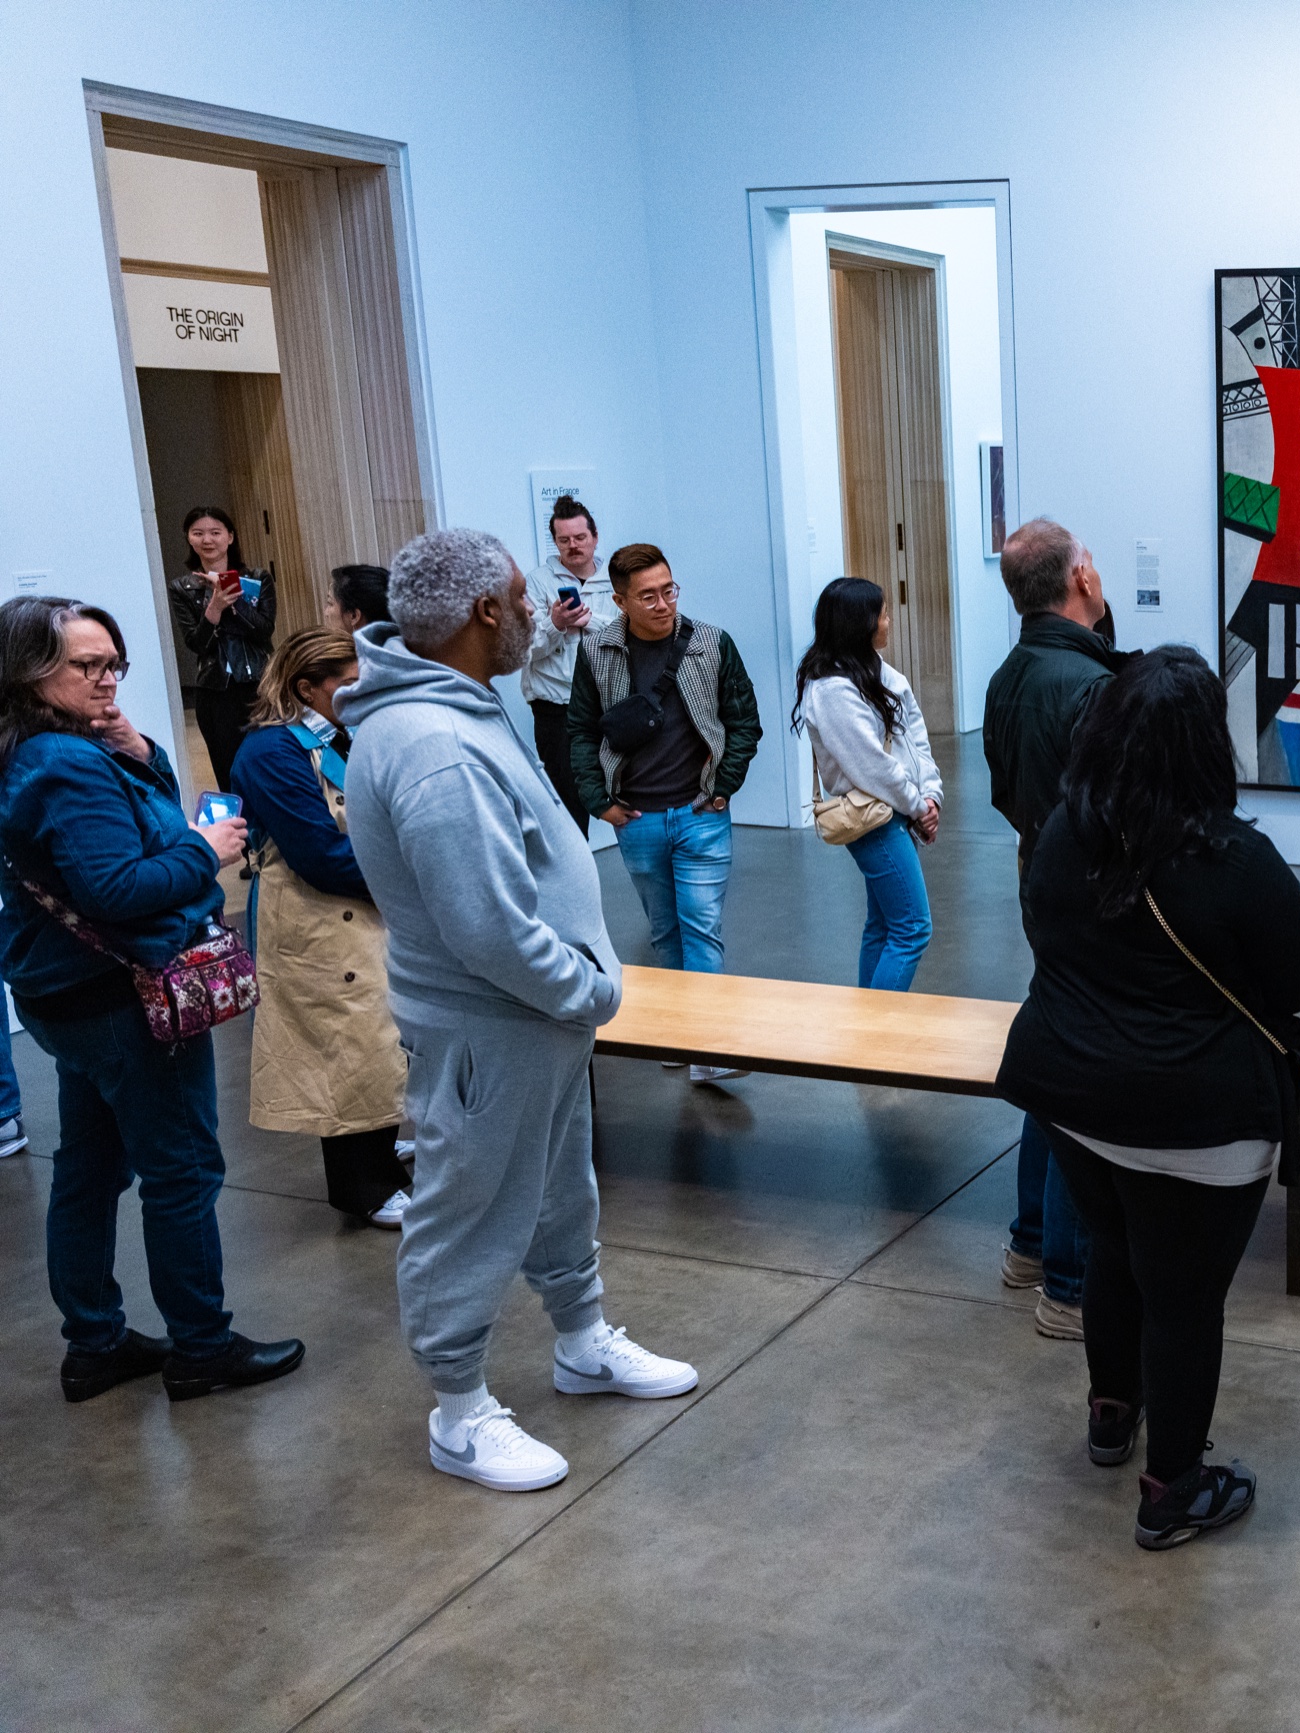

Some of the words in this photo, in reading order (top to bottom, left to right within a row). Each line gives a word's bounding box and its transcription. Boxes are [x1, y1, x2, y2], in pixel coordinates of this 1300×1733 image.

[166, 307, 194, 323] THE
[196, 309, 244, 327] ORIGIN
[176, 324, 195, 339] OF
[199, 326, 239, 343] NIGHT
[542, 487, 552, 495] Art
[553, 486, 558, 495] in
[559, 486, 579, 495] France
